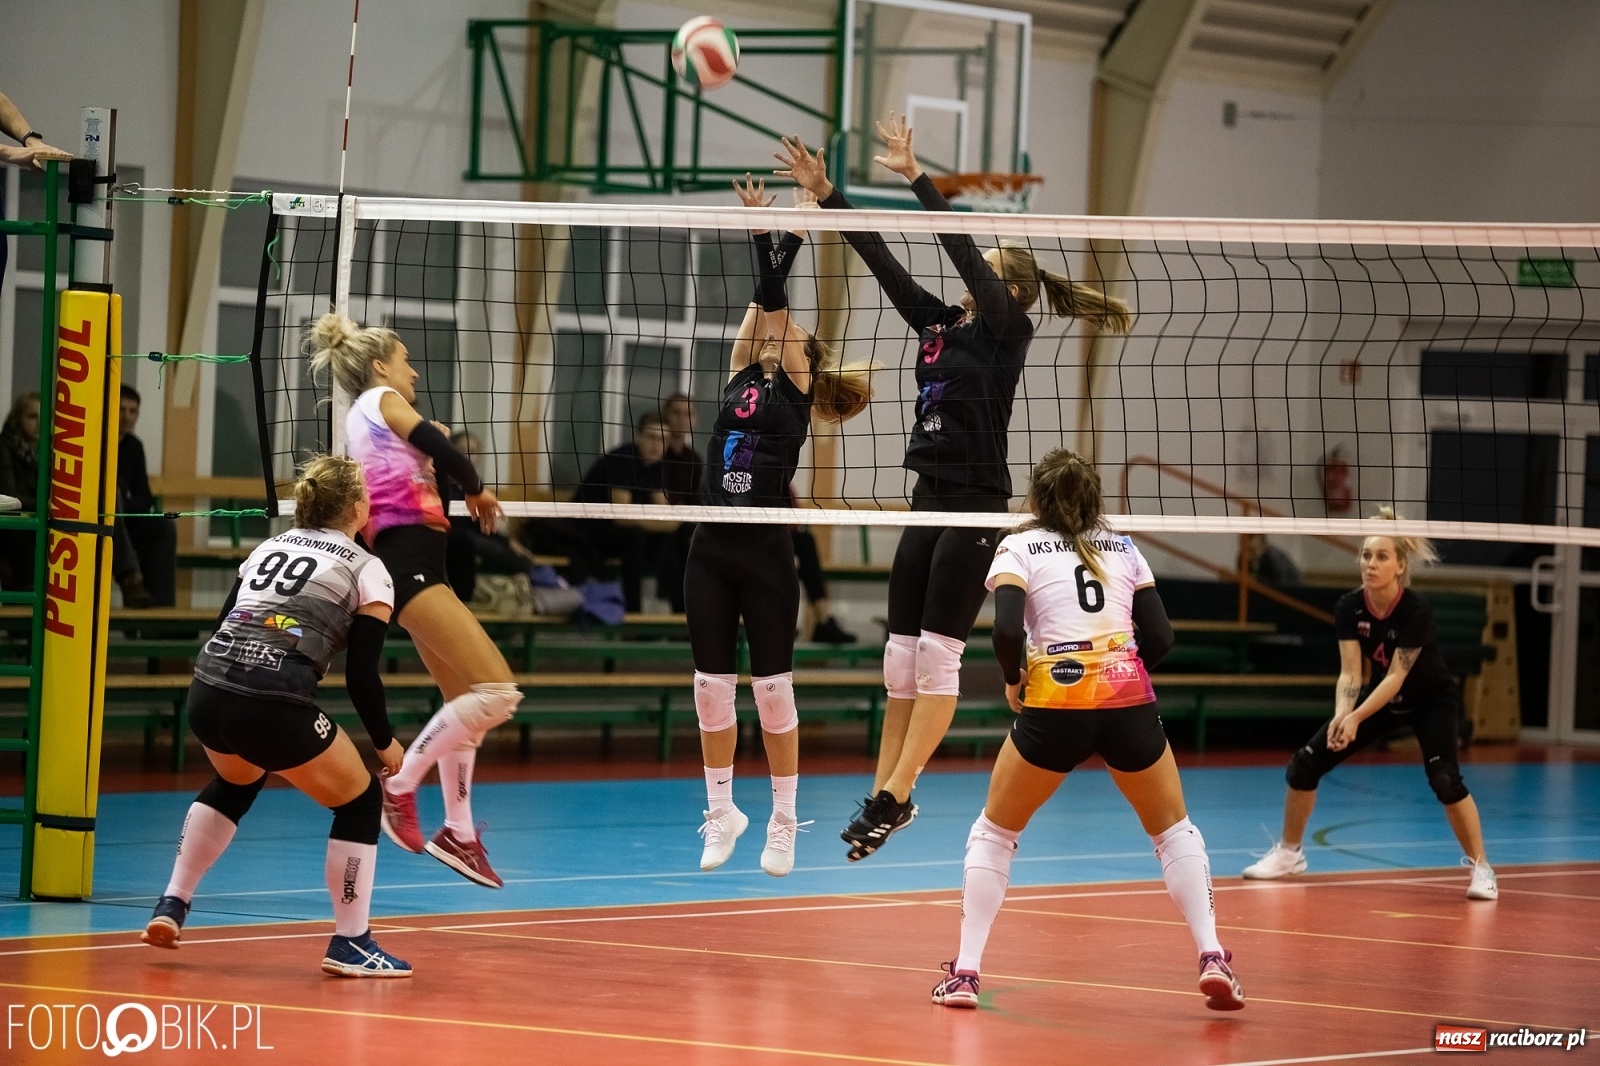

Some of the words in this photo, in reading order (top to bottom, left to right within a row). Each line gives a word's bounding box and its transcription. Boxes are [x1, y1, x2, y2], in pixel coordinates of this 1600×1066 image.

[734, 387, 759, 419] 3
[44, 319, 92, 638] PESMENPOL
[1027, 541, 1053, 555] UKS
[249, 551, 318, 597] 99
[1074, 564, 1105, 614] 6
[314, 712, 332, 739] 99
